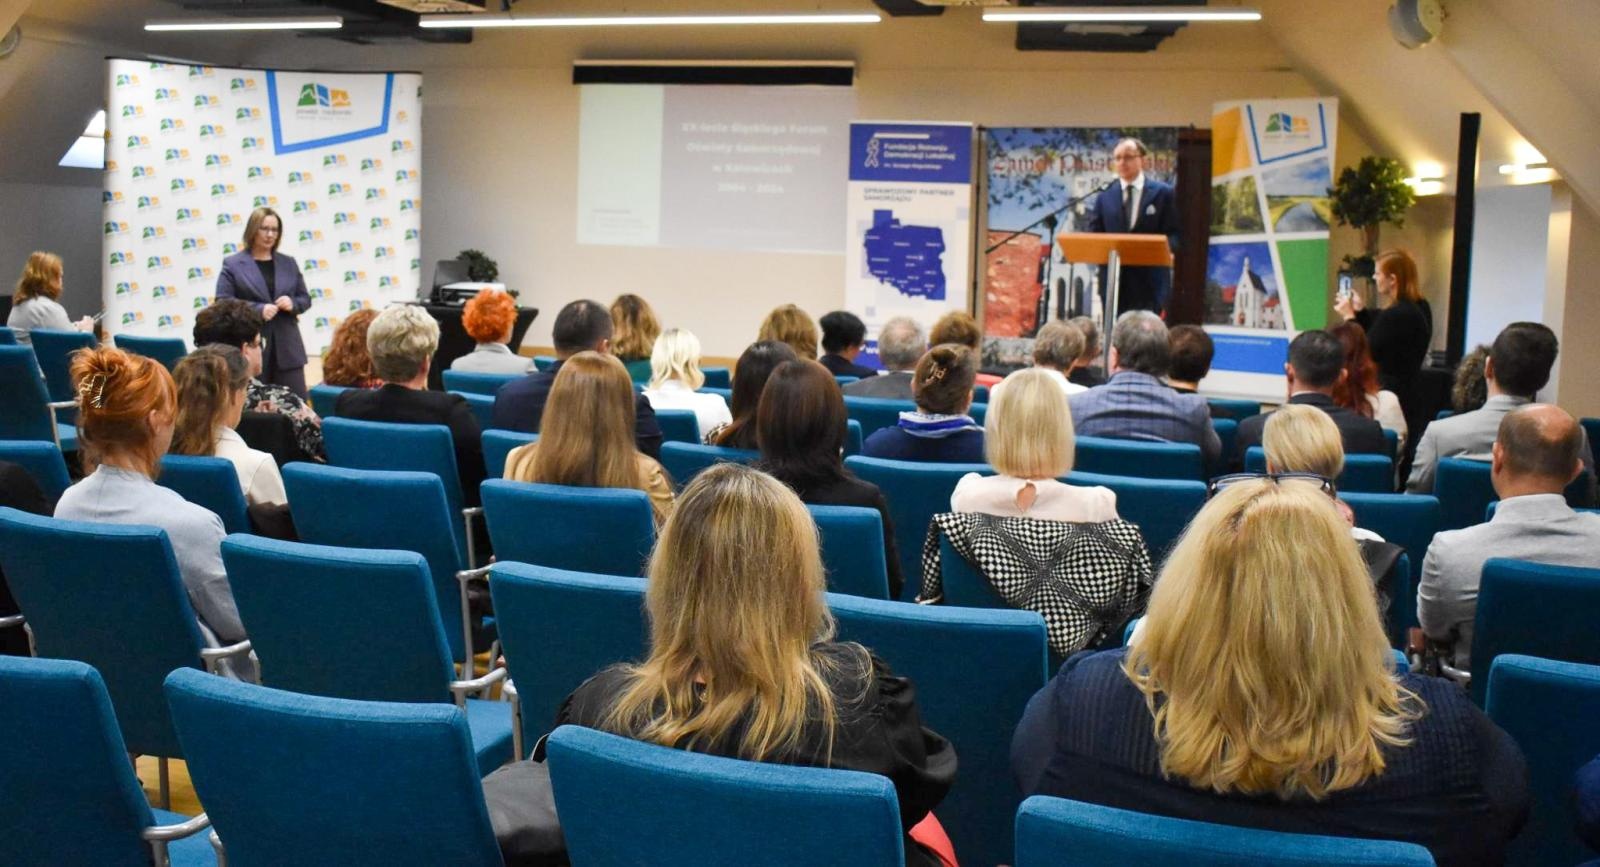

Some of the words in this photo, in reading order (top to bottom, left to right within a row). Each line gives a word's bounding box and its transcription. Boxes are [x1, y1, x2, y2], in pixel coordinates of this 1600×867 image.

[789, 124, 828, 134] Forum
[883, 143, 916, 151] Fundacja
[918, 144, 948, 152] Rozwoju
[883, 151, 924, 160] Demokracji
[925, 152, 956, 161] Lokalnej
